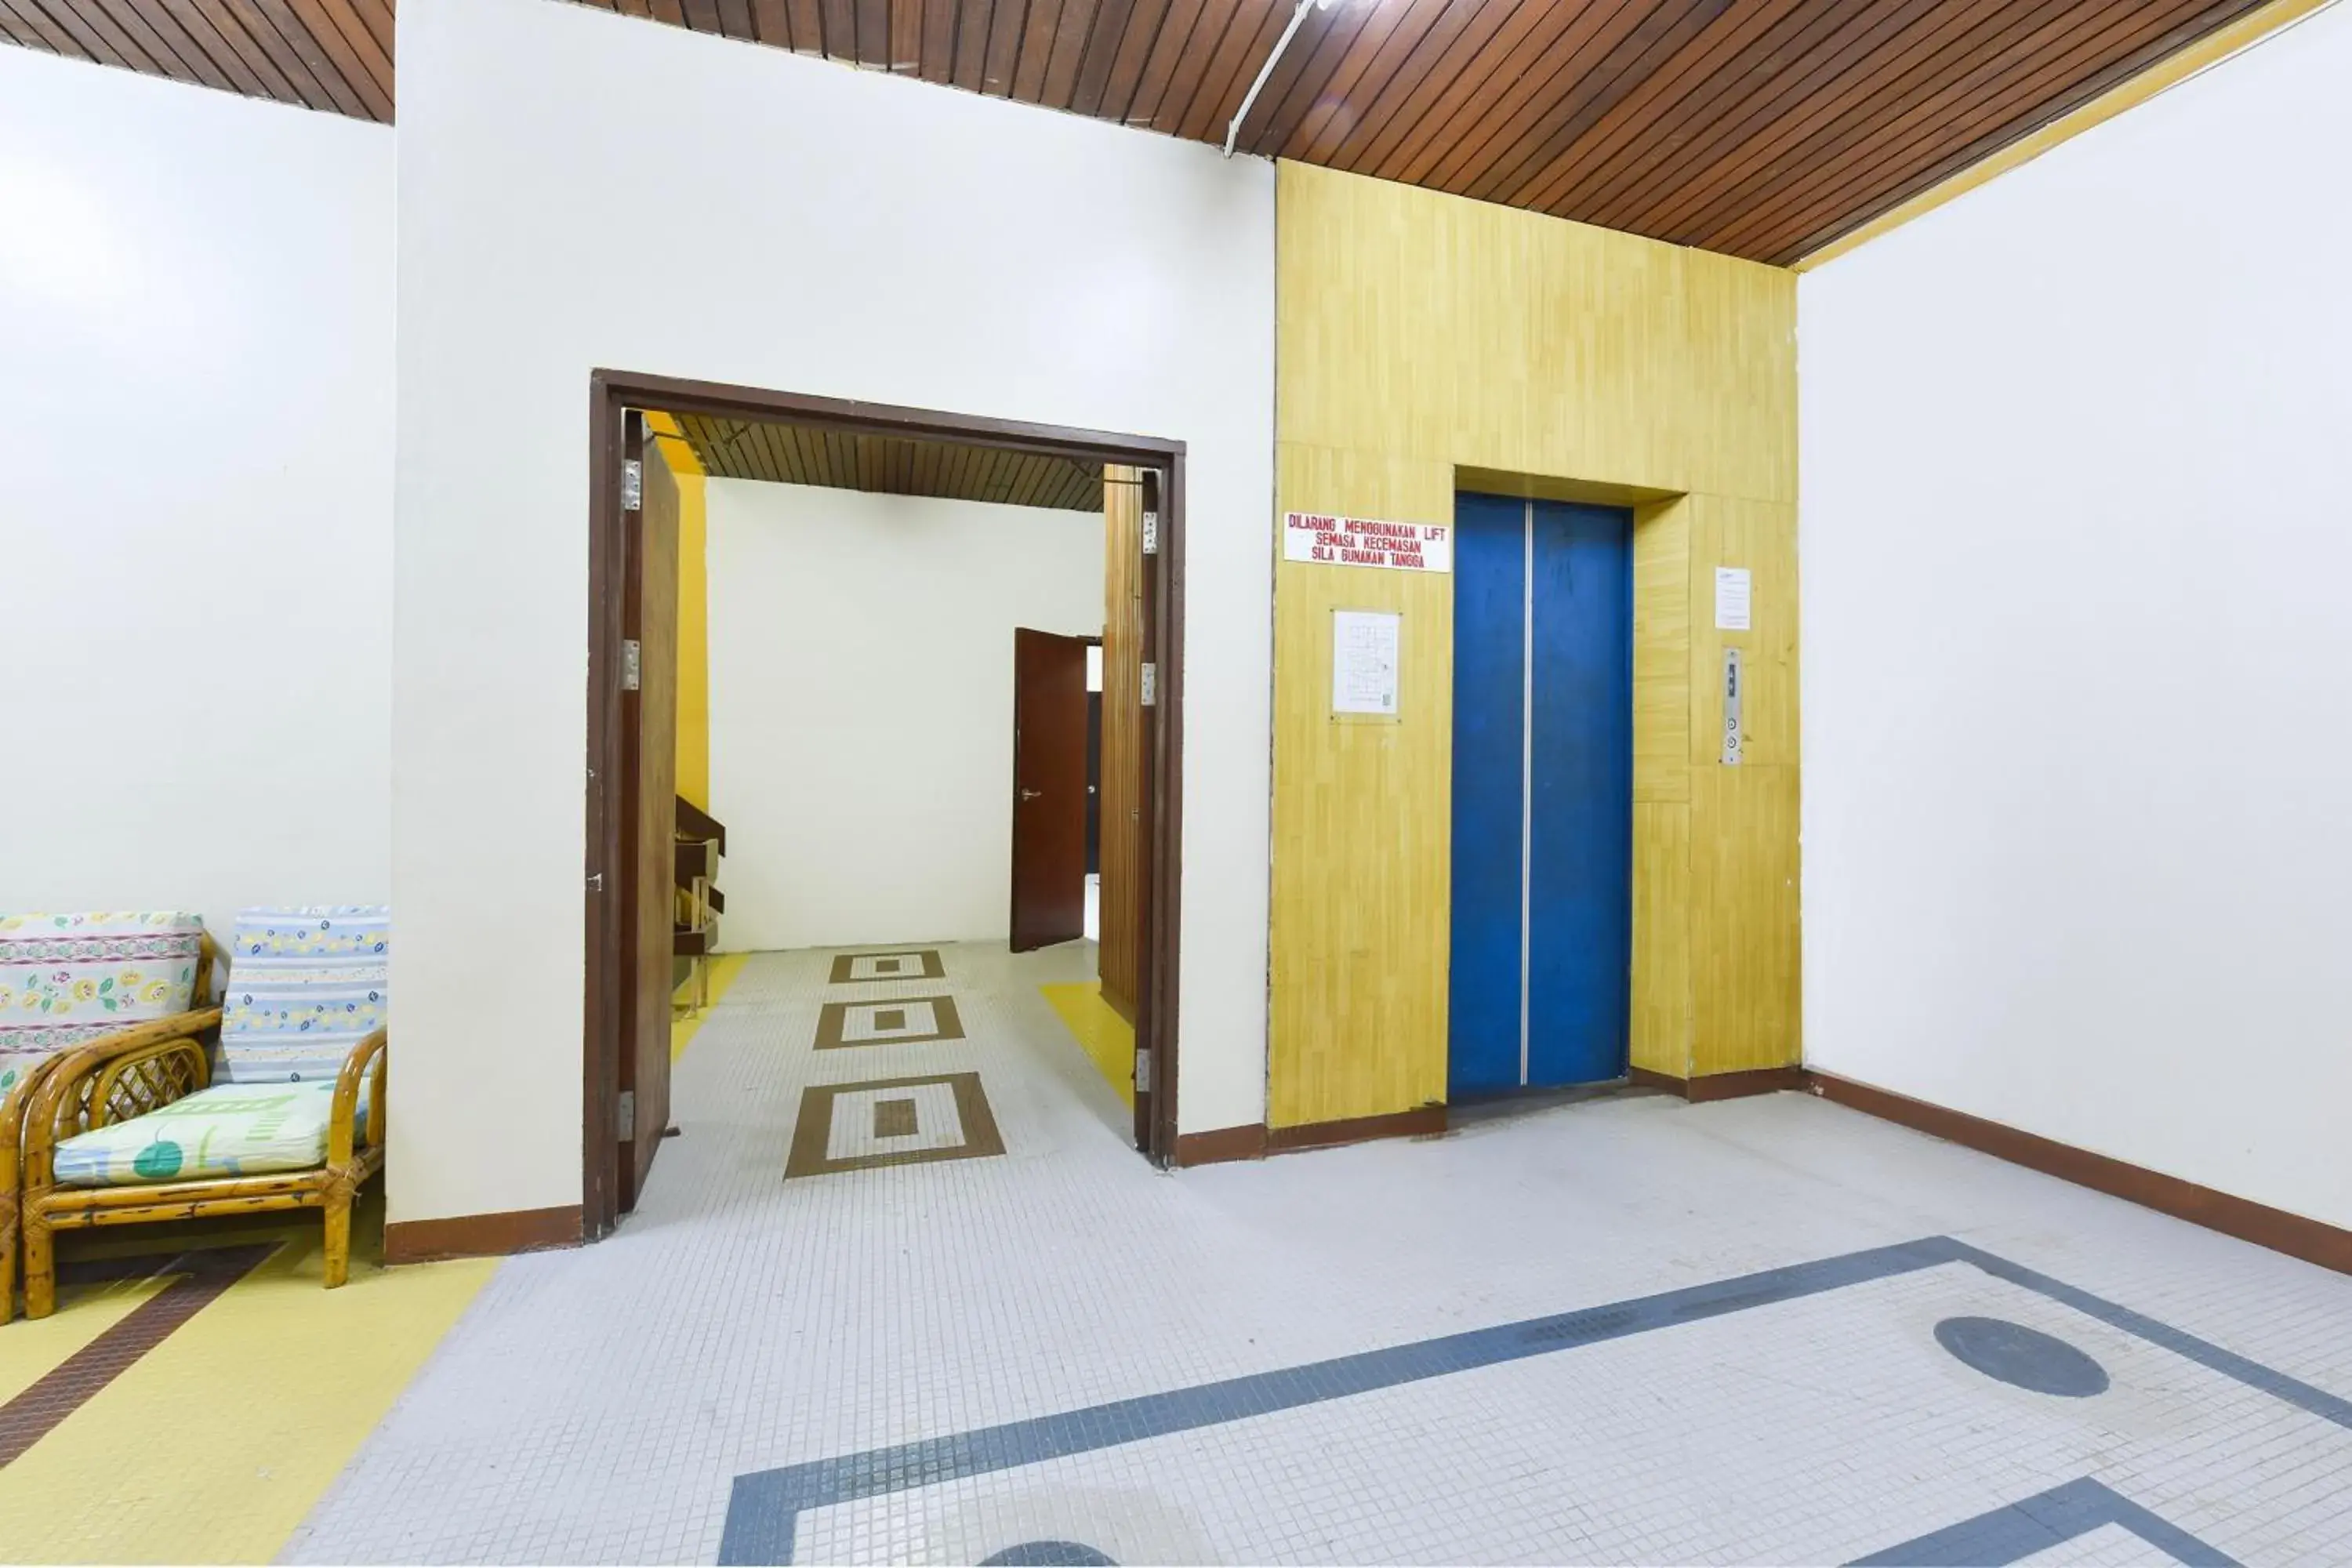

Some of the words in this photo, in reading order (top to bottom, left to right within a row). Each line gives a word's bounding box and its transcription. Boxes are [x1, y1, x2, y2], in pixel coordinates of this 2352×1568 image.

[1289, 514, 1336, 532] DILARANG
[1345, 519, 1415, 539] MENGGUNAKAN
[1425, 527, 1446, 541] LIFT
[1316, 532, 1356, 548] SEMASA
[1364, 536, 1421, 554] KECEMASAN
[1312, 546, 1334, 561] SILA
[1342, 549, 1385, 564] GUNAKAN
[1390, 552, 1425, 568] TANGGA
